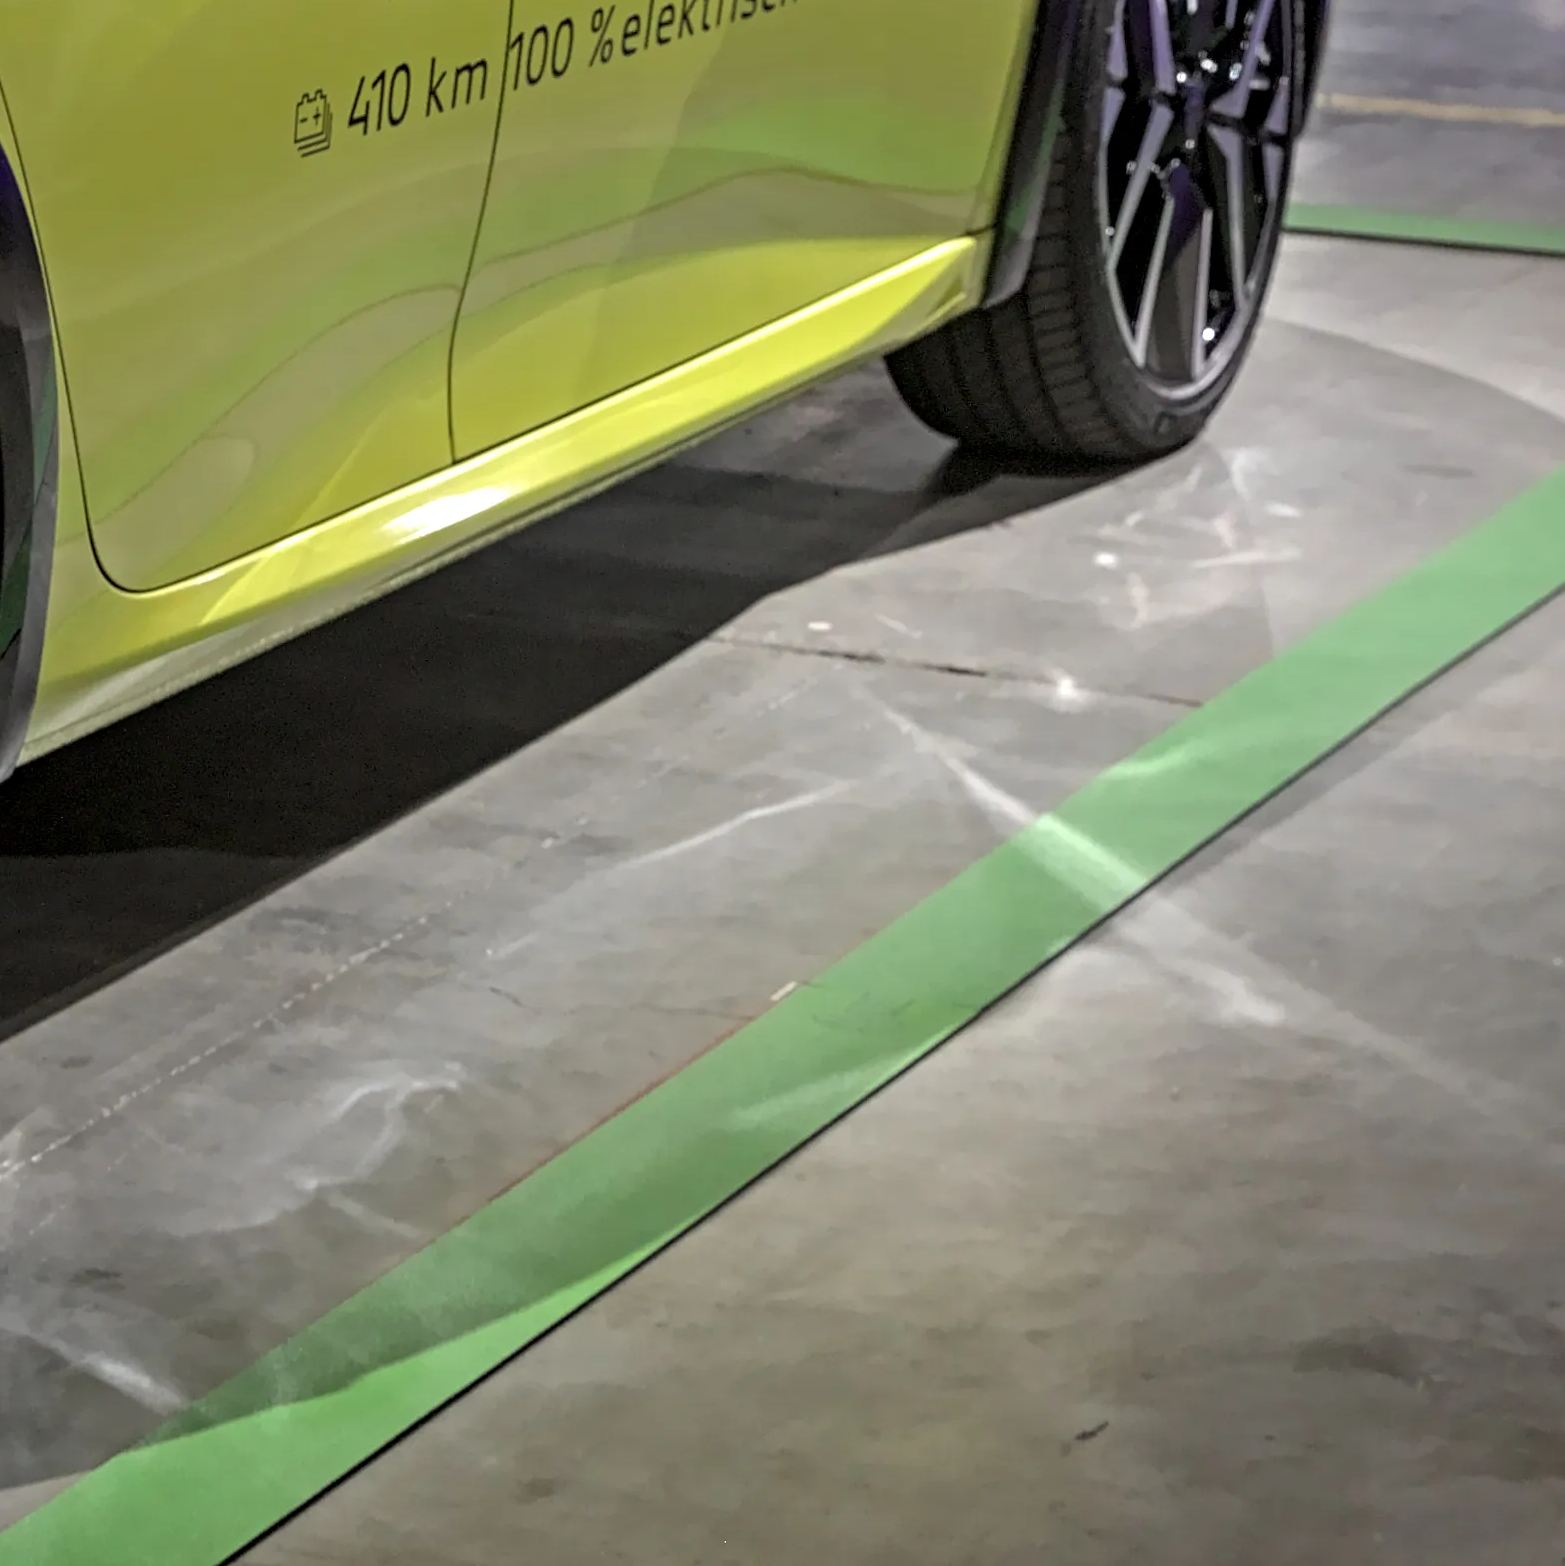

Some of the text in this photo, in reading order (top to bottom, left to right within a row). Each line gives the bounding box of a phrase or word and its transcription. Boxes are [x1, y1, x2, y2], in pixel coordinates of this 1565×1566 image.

[347, 62, 412, 136] 410
[425, 56, 488, 118] km
[507, 17, 574, 91] 100
